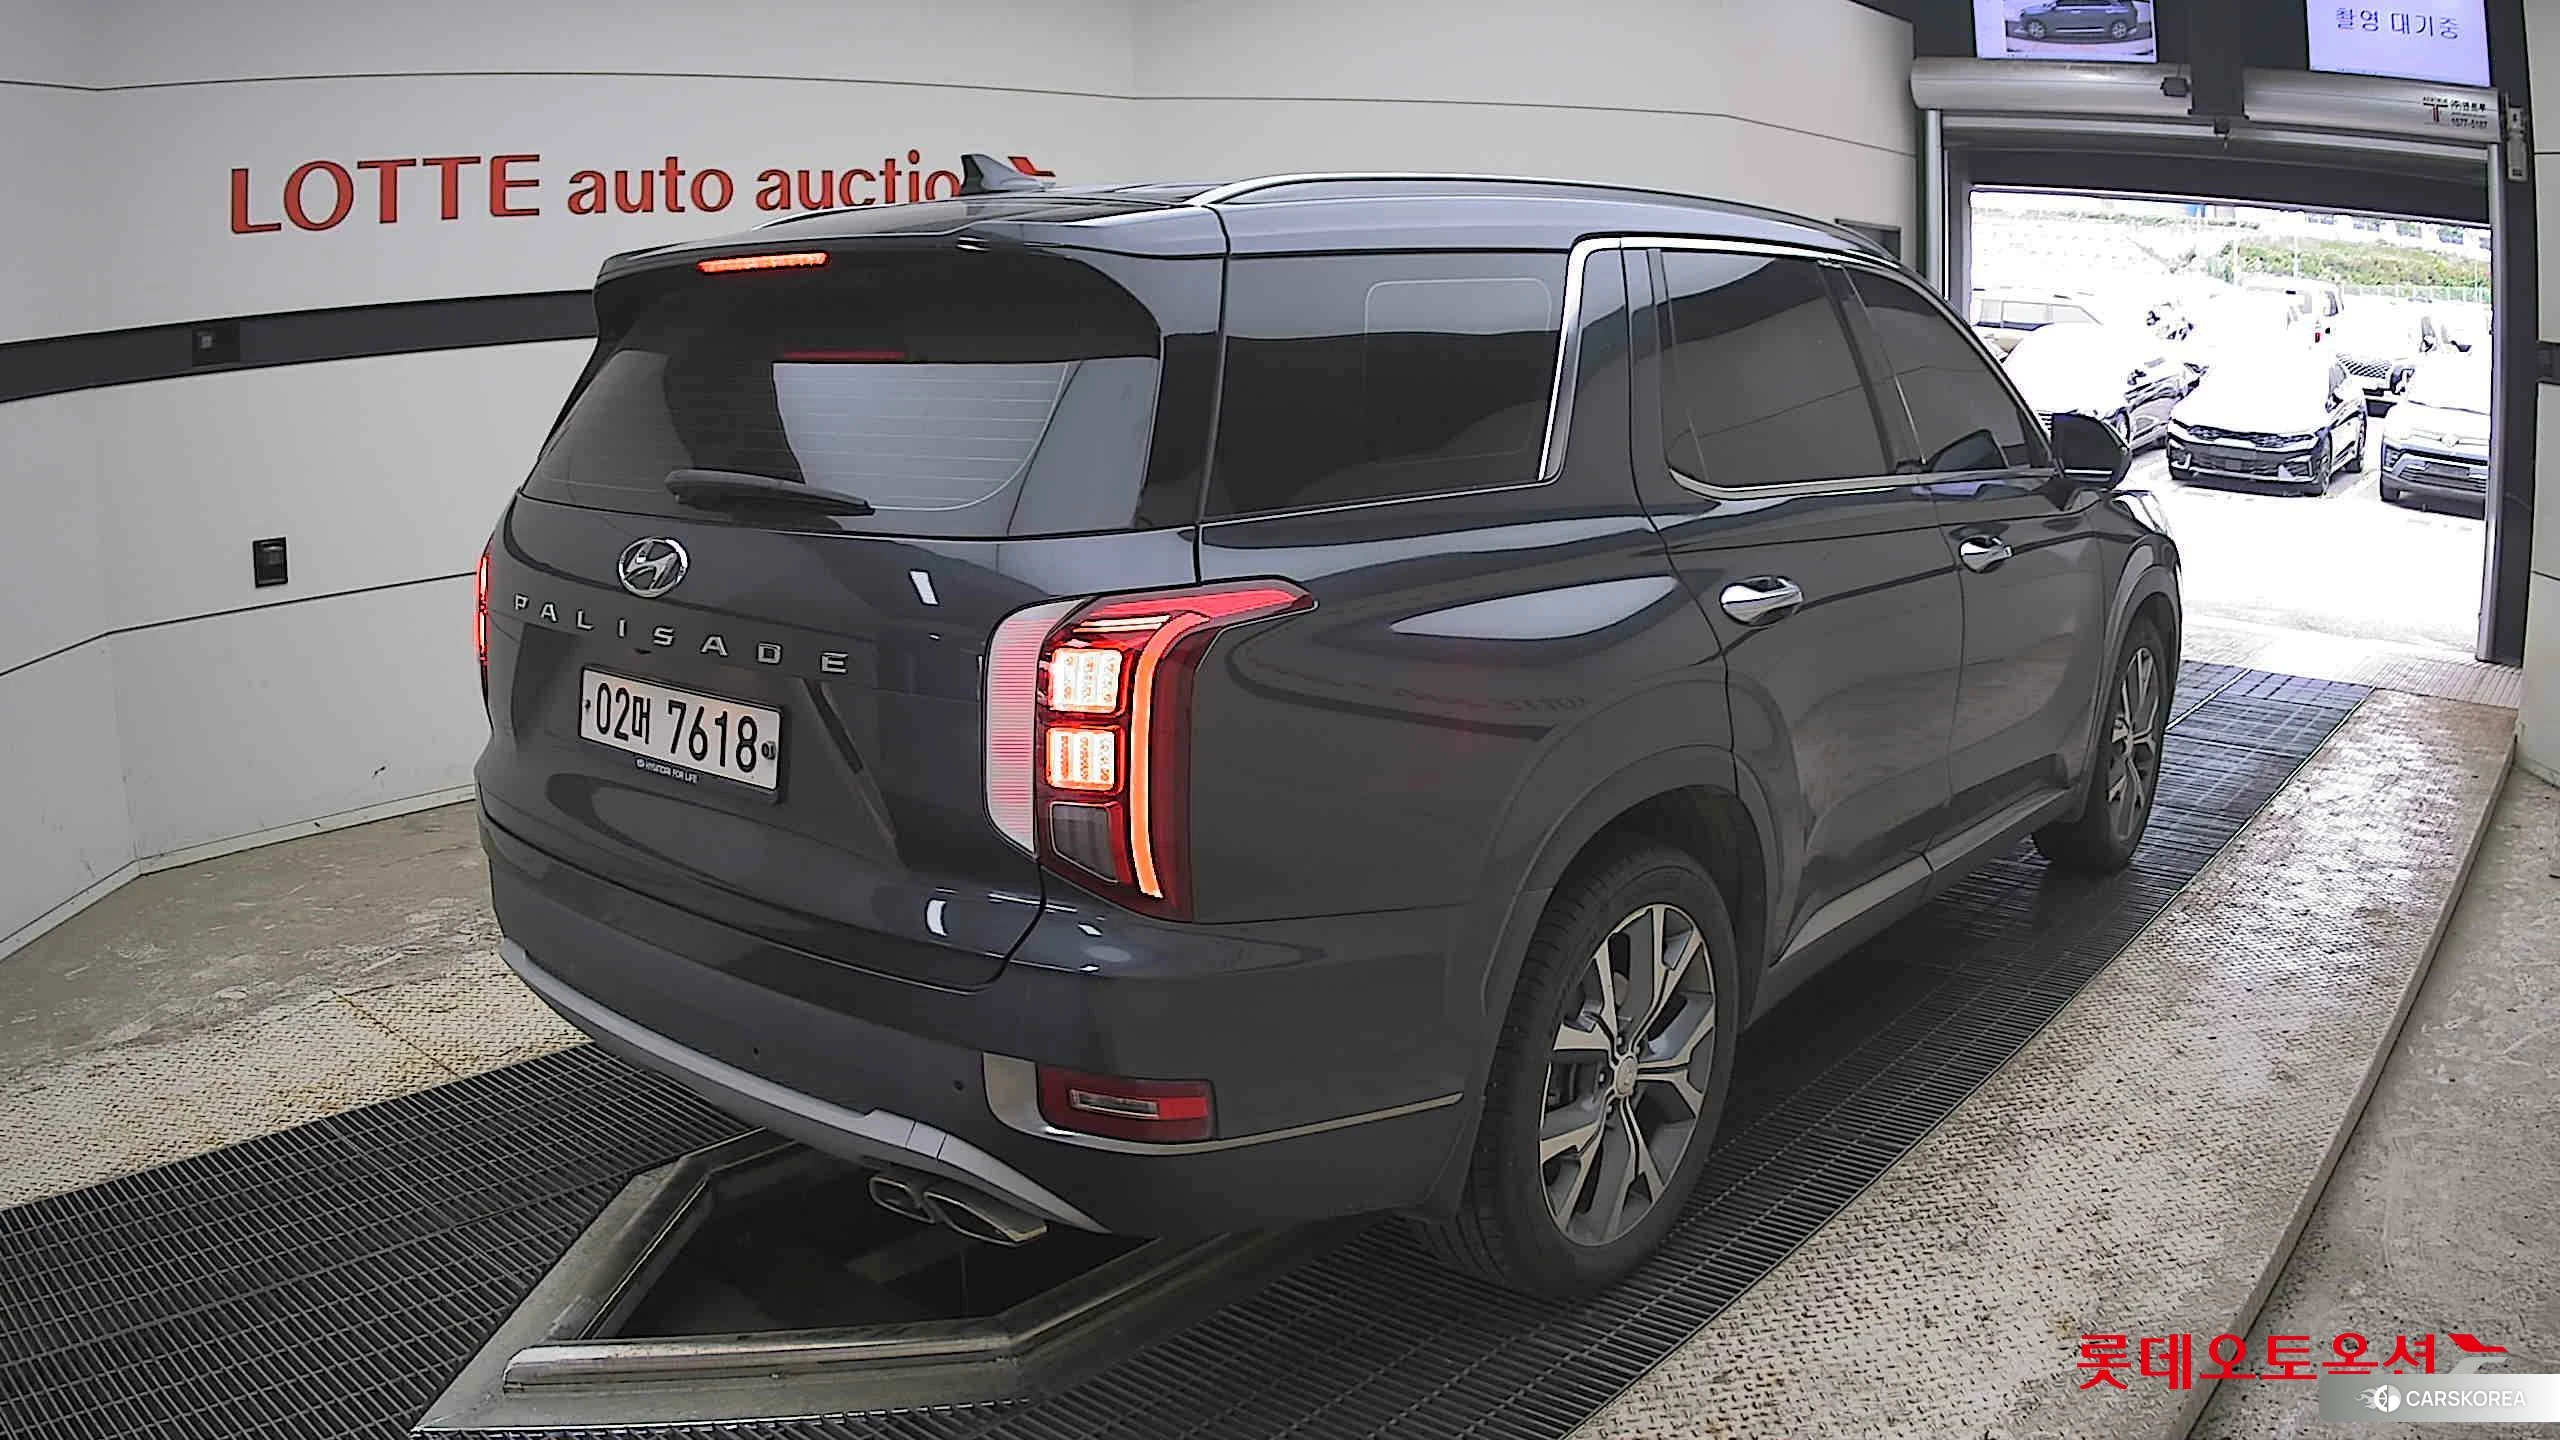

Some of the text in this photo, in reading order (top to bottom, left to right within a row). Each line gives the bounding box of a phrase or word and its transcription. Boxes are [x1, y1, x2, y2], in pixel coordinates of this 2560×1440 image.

[2336, 7, 2460, 40] 촬영 대기중
[230, 149, 962, 235] LOTTE auto auctio
[514, 593, 849, 674] PALISADE
[596, 682, 758, 773] 02머 7618
